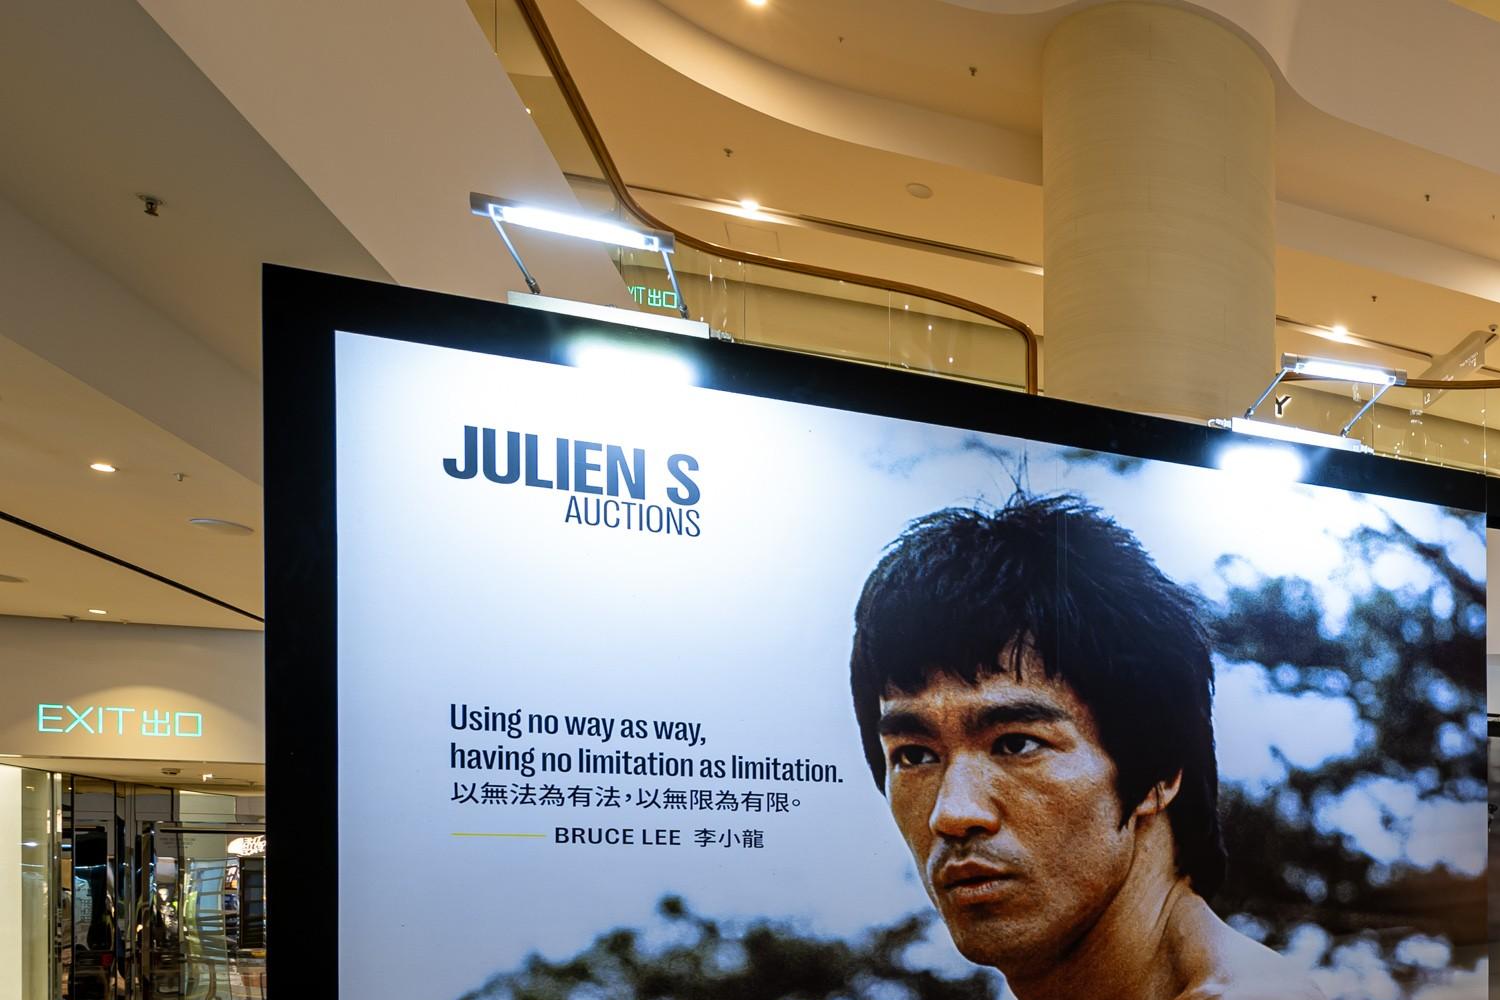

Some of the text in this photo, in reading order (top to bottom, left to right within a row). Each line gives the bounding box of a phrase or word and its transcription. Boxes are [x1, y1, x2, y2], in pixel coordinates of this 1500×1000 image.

[648, 288, 678, 309] 出口
[565, 495, 701, 537] AUCTIONS
[37, 704, 202, 737] EXIT 出口
[450, 704, 706, 747] Using no way as way,
[450, 742, 844, 783] having no limitation as limitation.
[450, 782, 801, 813] 以無法為有法，以無限為有限。
[555, 827, 765, 848] BRUCE LEE 李小龍
